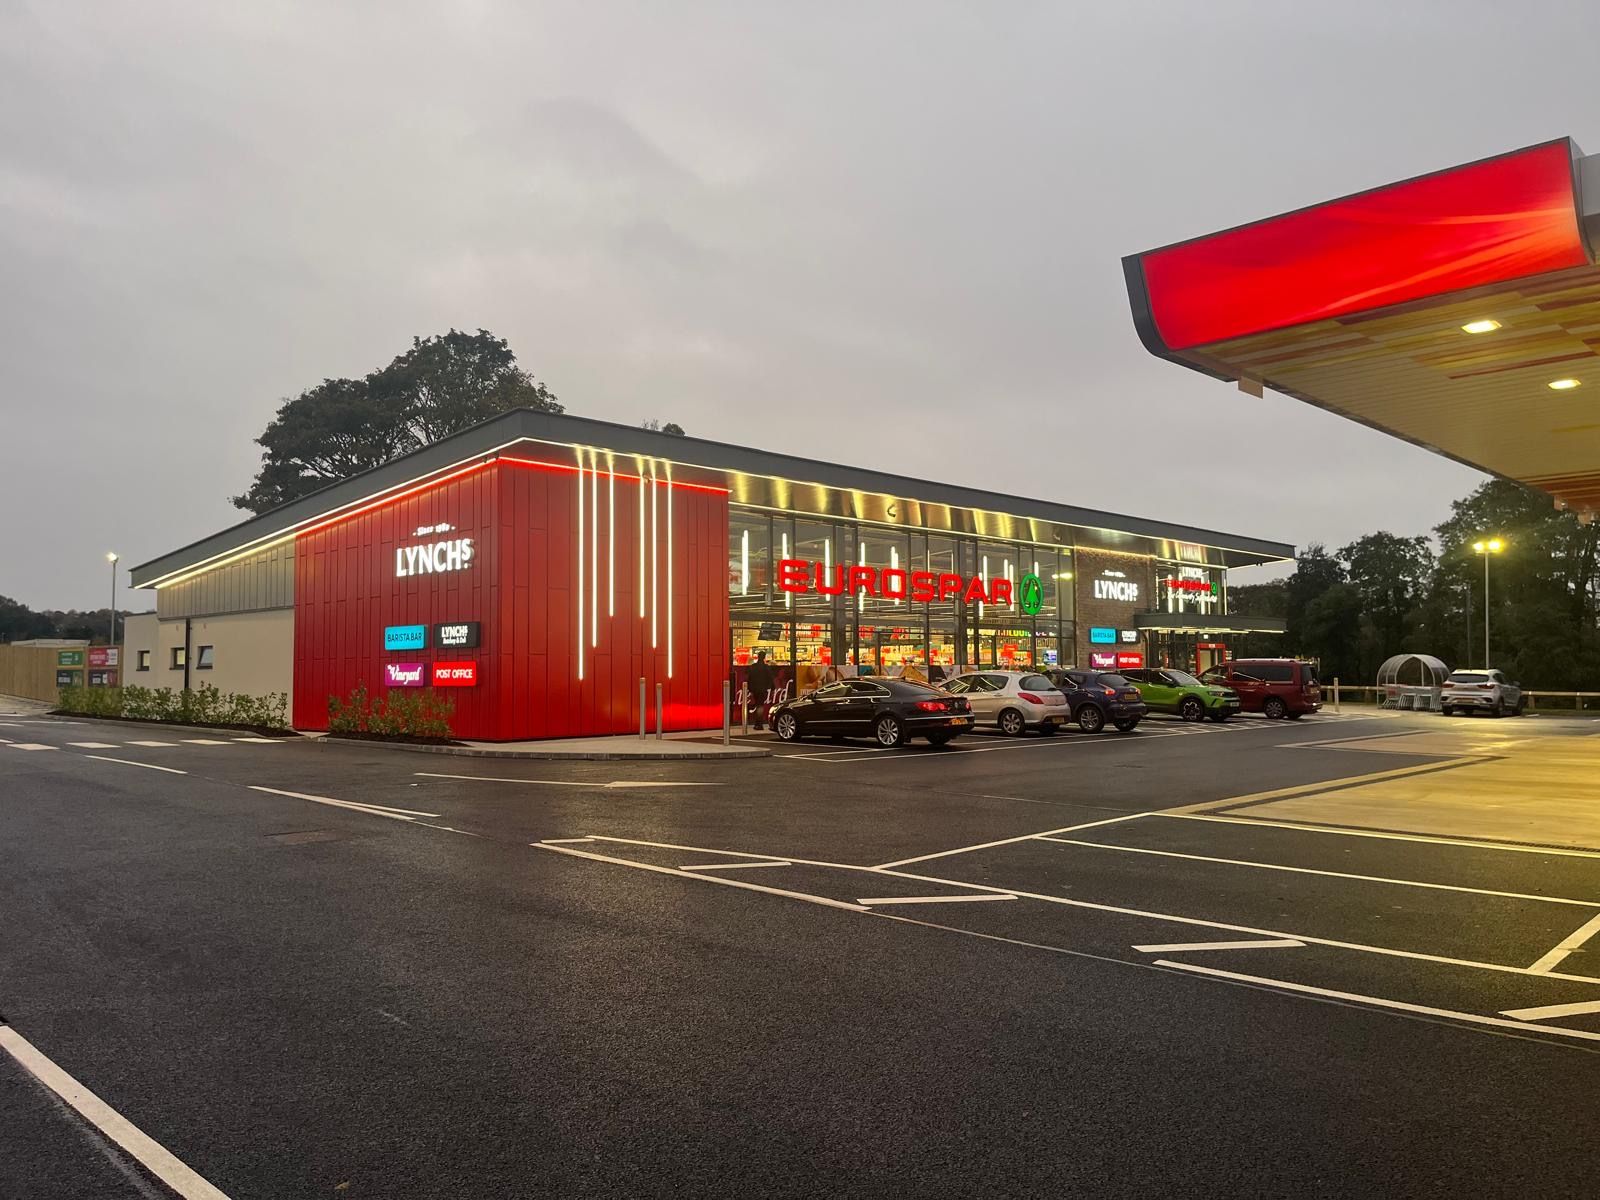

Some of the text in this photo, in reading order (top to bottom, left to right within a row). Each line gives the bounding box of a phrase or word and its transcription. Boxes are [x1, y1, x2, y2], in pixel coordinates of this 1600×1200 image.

[778, 559, 1013, 605] EUROSPAR
[388, 632, 422, 642] BARISTA BAR
[436, 669, 473, 679] POST OFFICE
